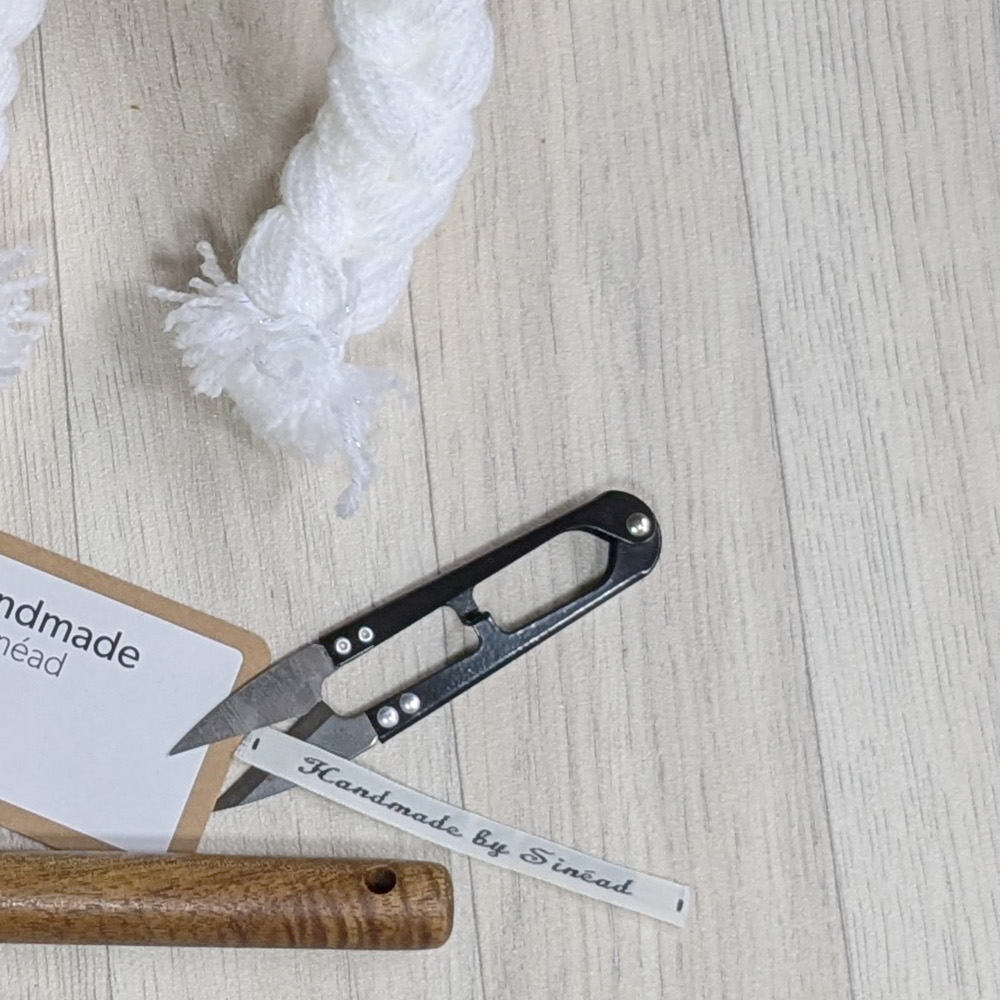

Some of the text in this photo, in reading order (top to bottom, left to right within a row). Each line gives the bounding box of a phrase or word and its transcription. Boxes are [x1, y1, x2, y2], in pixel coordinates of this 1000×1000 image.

[298, 757, 636, 897] Handmade by Sinéad
